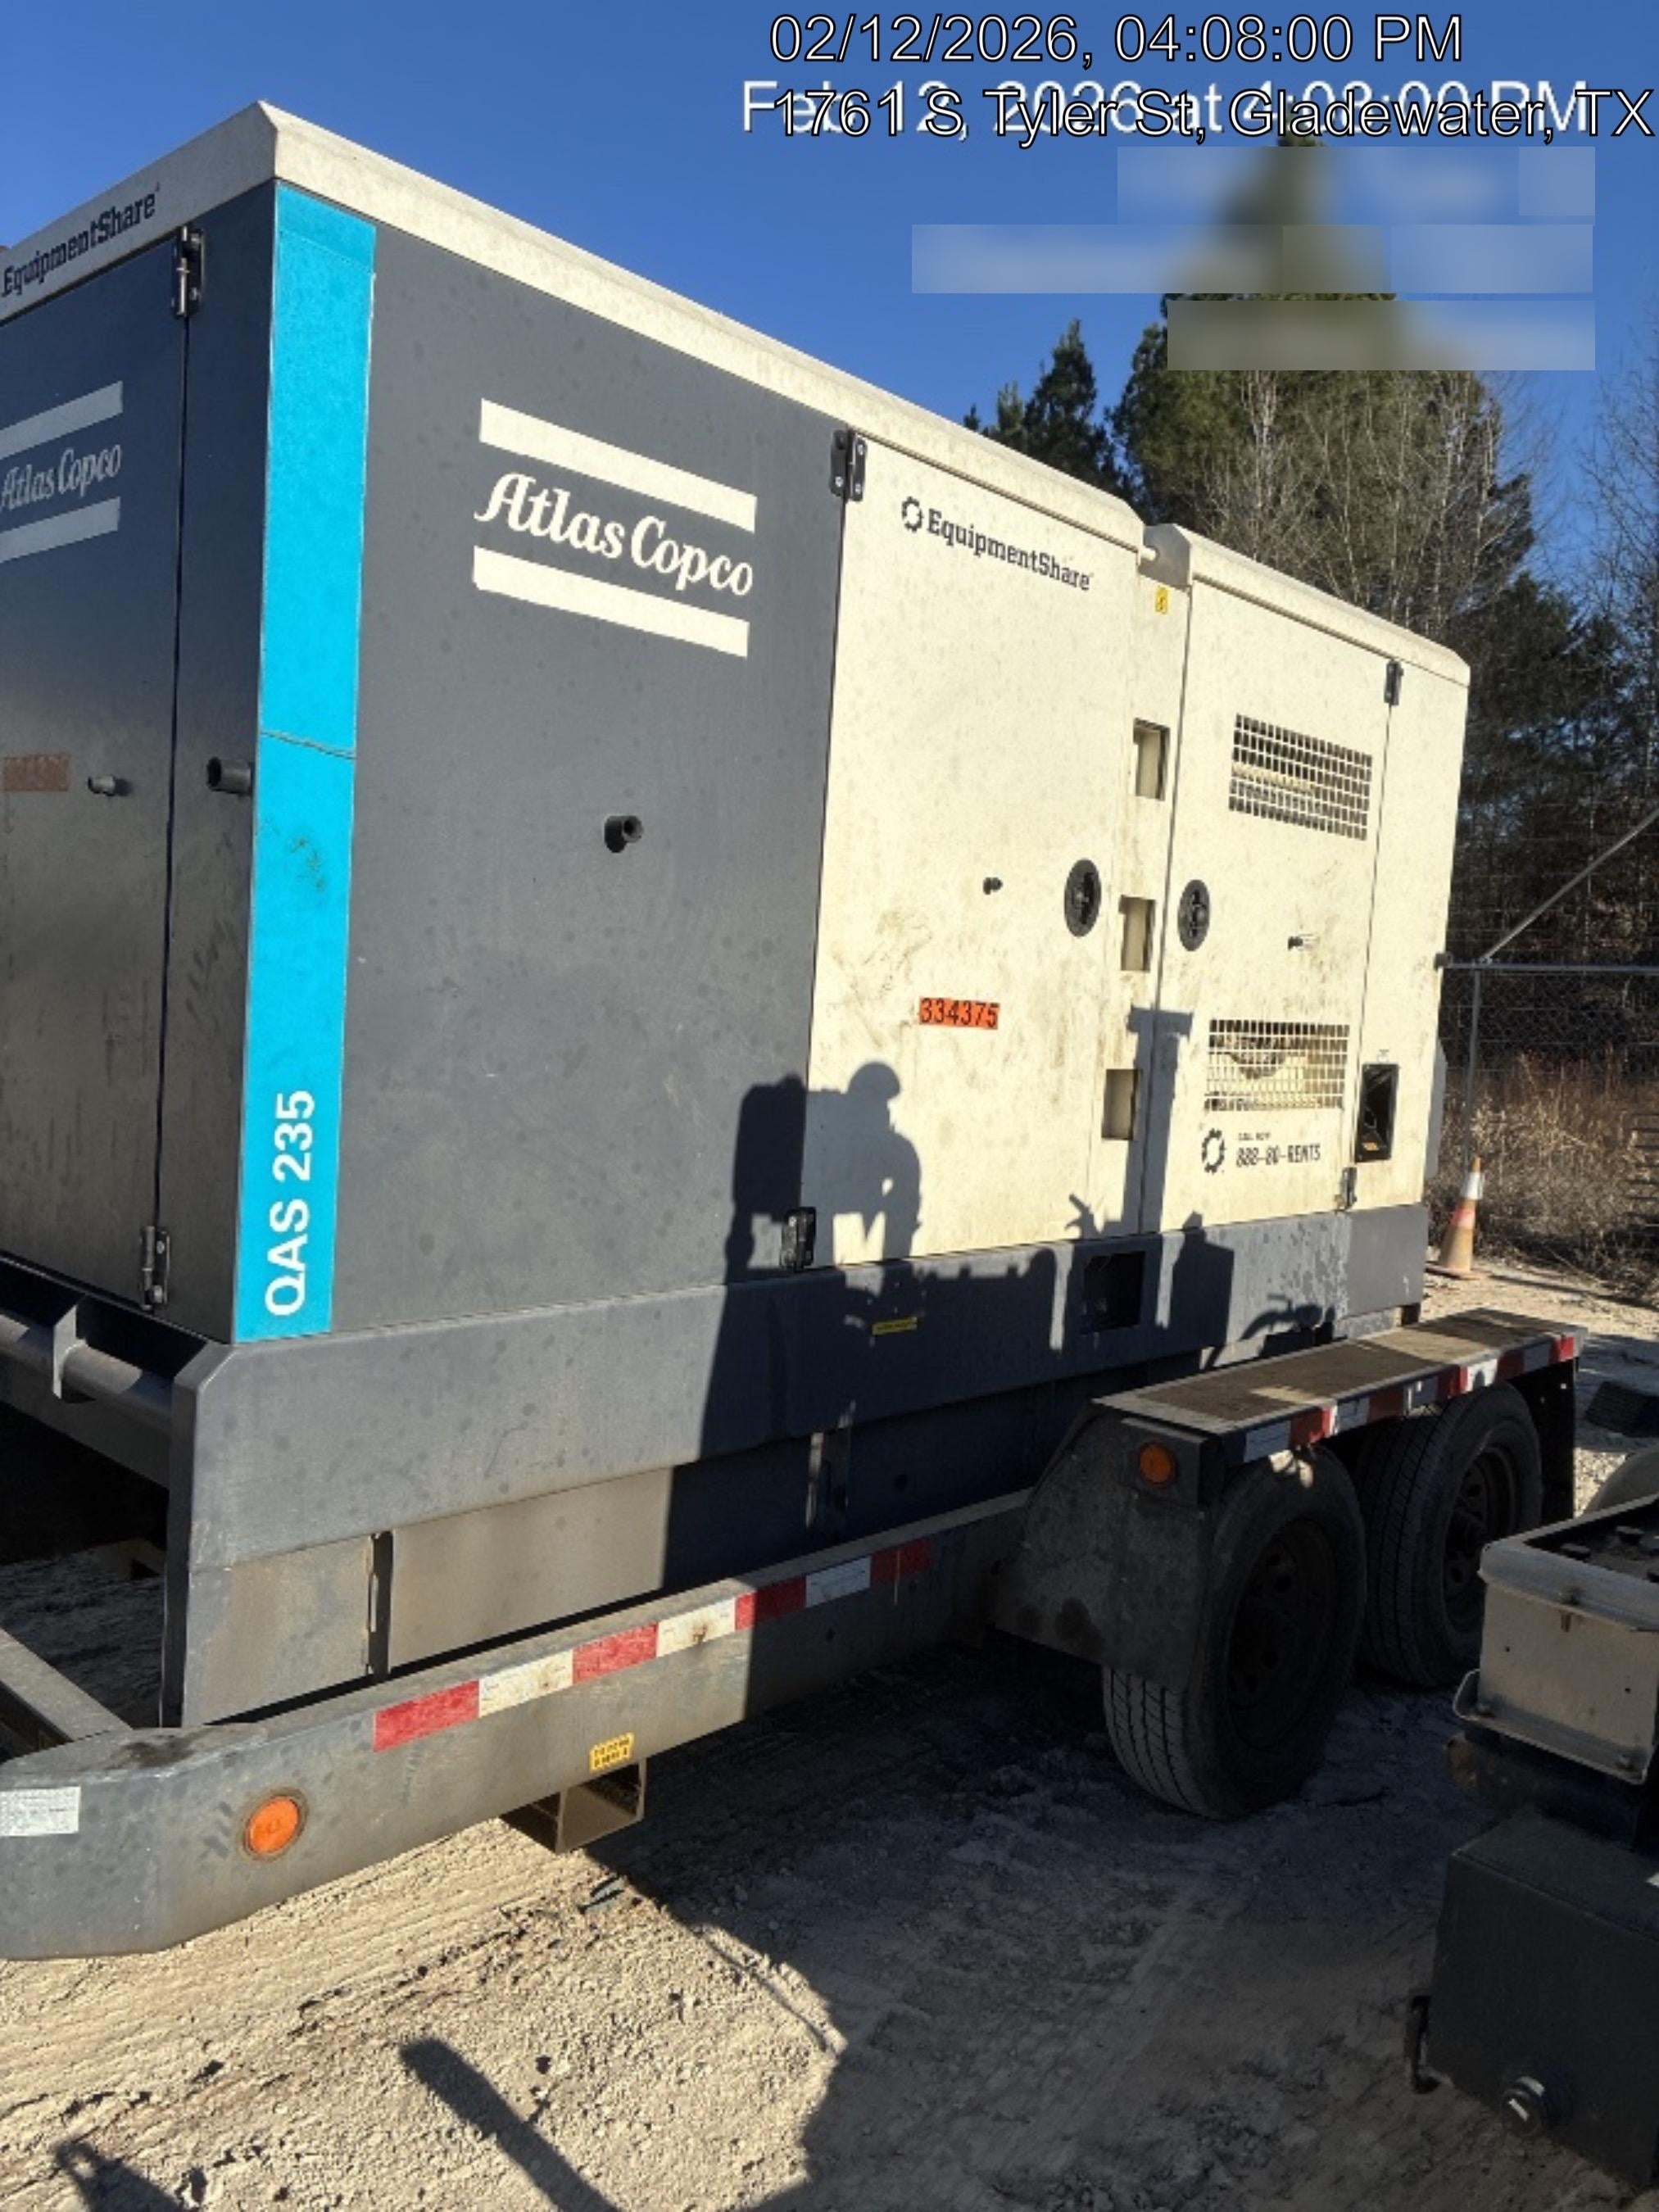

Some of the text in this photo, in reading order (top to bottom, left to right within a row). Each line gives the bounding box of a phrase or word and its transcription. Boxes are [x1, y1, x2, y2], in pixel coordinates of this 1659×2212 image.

[2, 193, 156, 297] EquipmentShare
[0, 444, 121, 512] Atlas Copco
[474, 473, 753, 596] Atlas Copco
[927, 508, 1090, 591] EquipmentShare
[921, 997, 999, 1028] 334375
[265, 1090, 315, 1317] QAS 235
